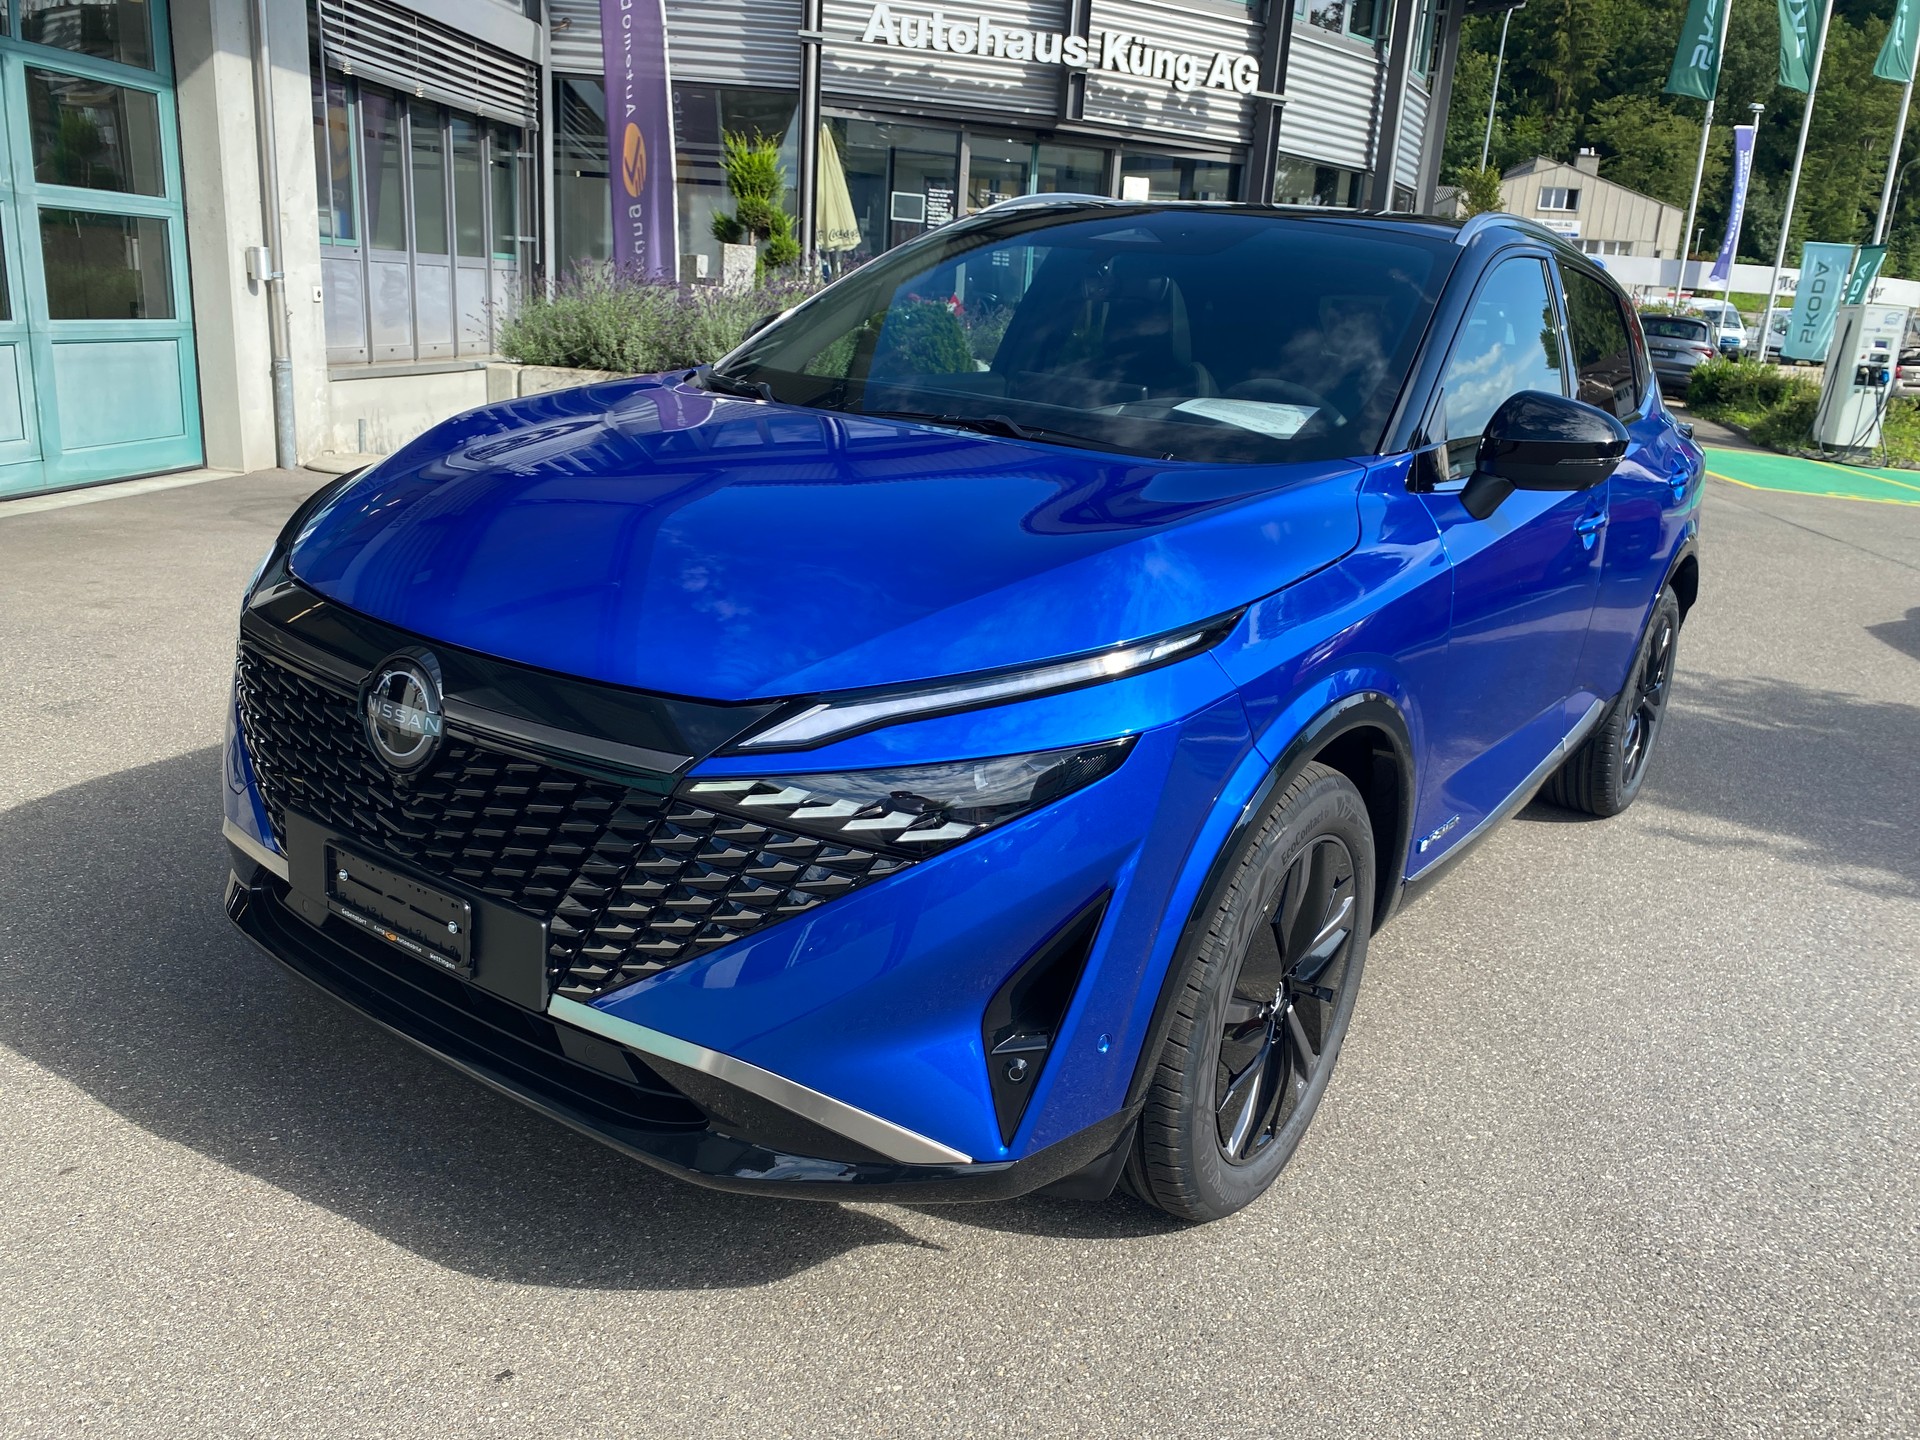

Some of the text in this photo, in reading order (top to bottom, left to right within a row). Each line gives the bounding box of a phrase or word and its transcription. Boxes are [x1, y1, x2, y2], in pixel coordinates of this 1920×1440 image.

[862, 3, 1260, 94] Autohaus Küng AG
[367, 694, 440, 733] NISSAN
